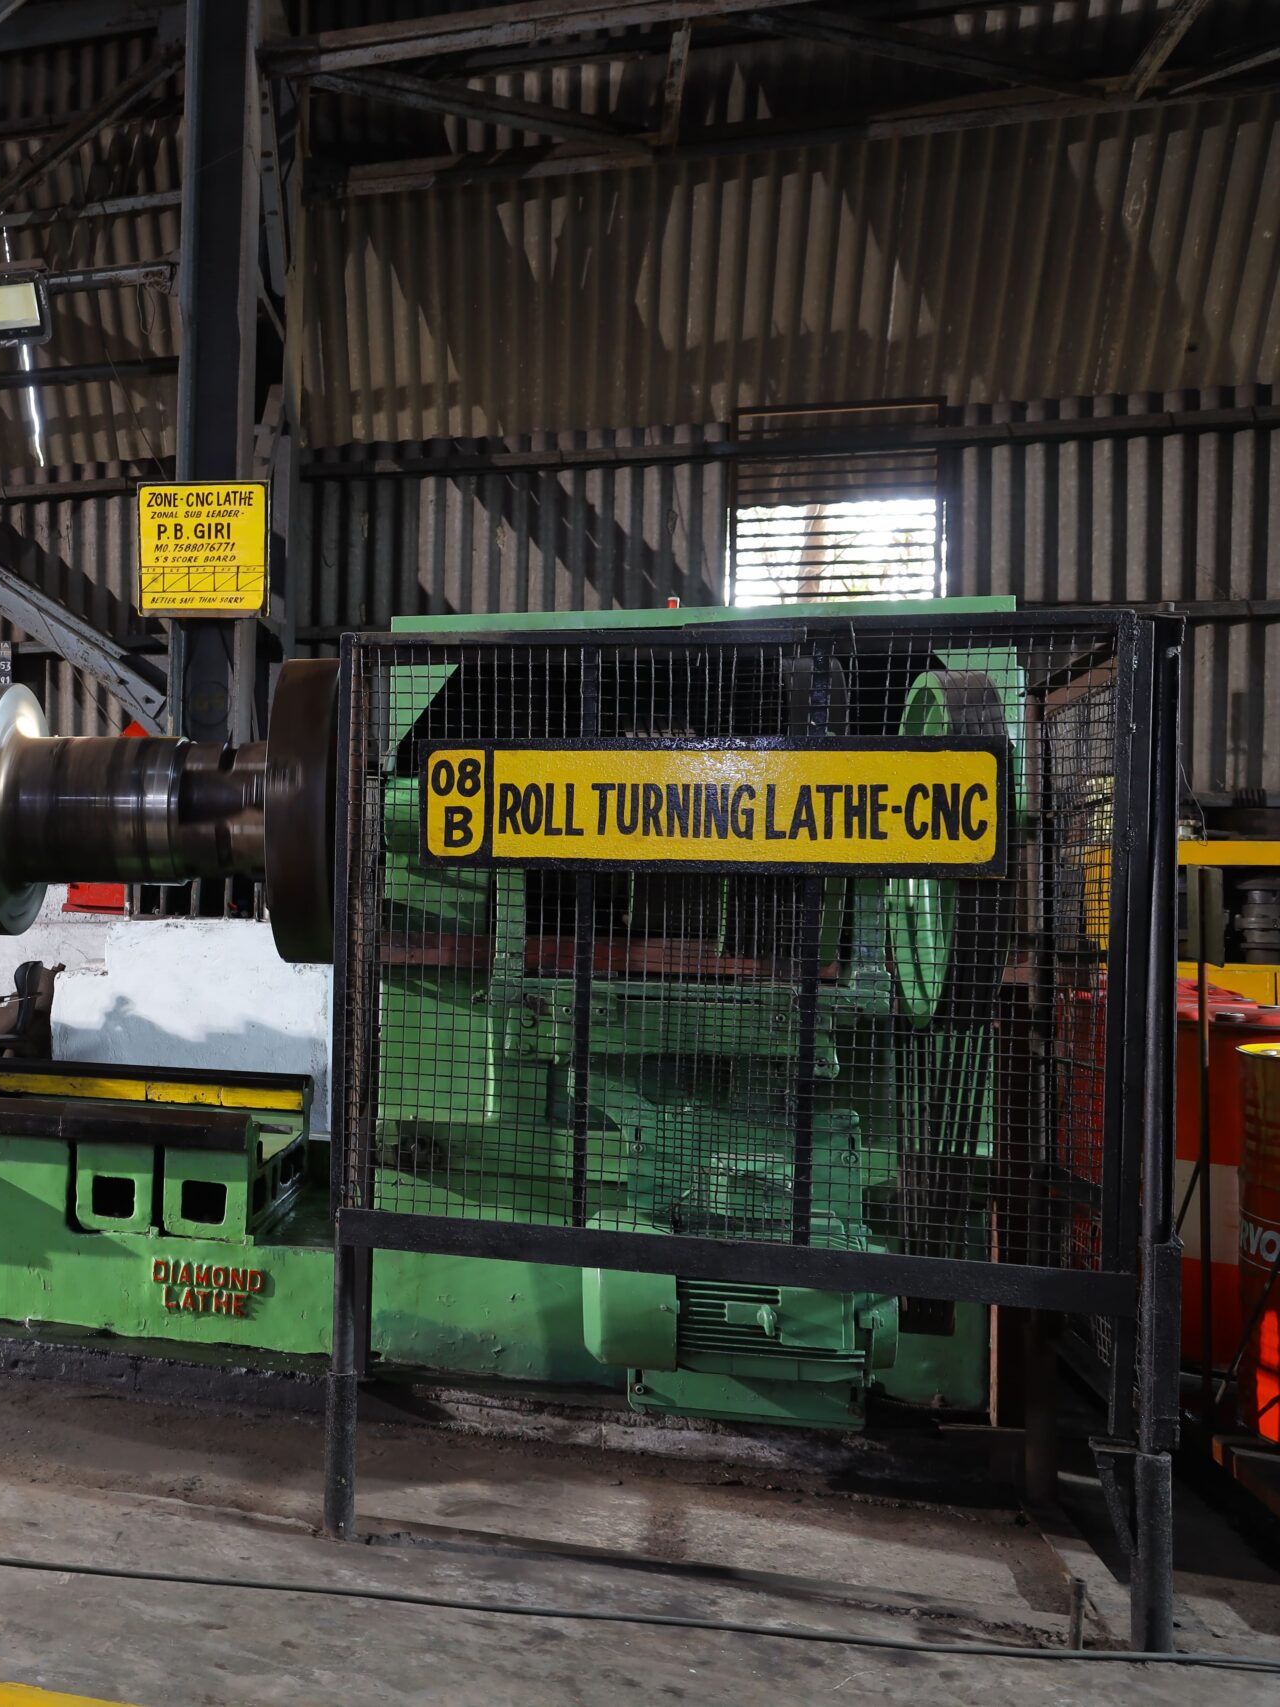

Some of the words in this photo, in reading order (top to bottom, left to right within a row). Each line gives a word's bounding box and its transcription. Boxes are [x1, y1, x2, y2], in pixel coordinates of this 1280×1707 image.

[150, 511, 179, 519] ZONAL
[184, 510, 202, 519] SUB
[216, 491, 254, 507] LATHE
[171, 555, 199, 563] SCORE
[204, 555, 236, 563] BOARD
[150, 596, 176, 604] BETTER
[198, 596, 217, 604] THAN
[219, 596, 245, 604] SORRY
[430, 758, 482, 798] 08
[443, 806, 473, 848] B
[498, 783, 585, 837] ROLL
[591, 783, 754, 840] TURNING
[153, 1258, 264, 1293] DIAMOND
[163, 1285, 247, 1316] LATHE
